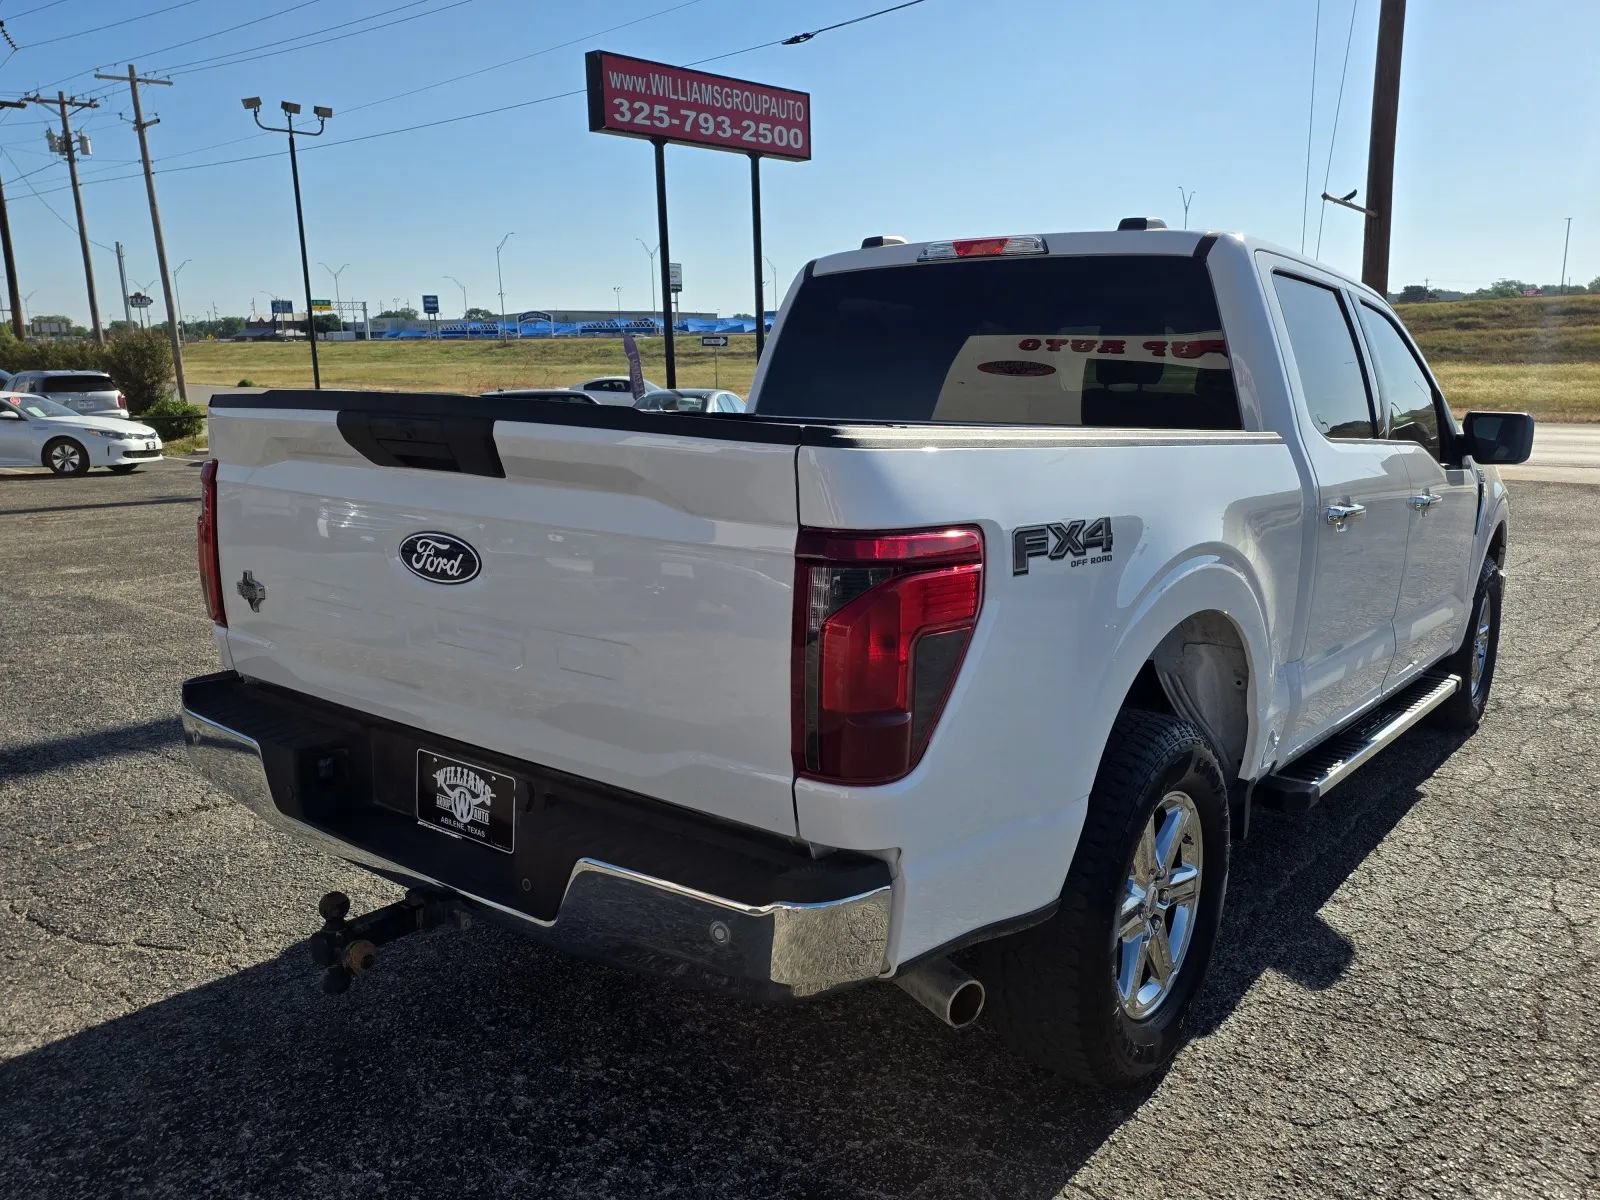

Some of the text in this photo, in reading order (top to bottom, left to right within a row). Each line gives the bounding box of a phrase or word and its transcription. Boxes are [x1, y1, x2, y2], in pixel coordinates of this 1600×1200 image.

[613, 98, 803, 148] 325-793-2500
[412, 539, 463, 576] Ford
[1012, 516, 1113, 576] FX4
[1071, 555, 1113, 567] OFF ROAD
[436, 766, 492, 806] WILLIAMS
[441, 816, 485, 838] ABILENE, TEXAS
[474, 809, 489, 823] AUTO
